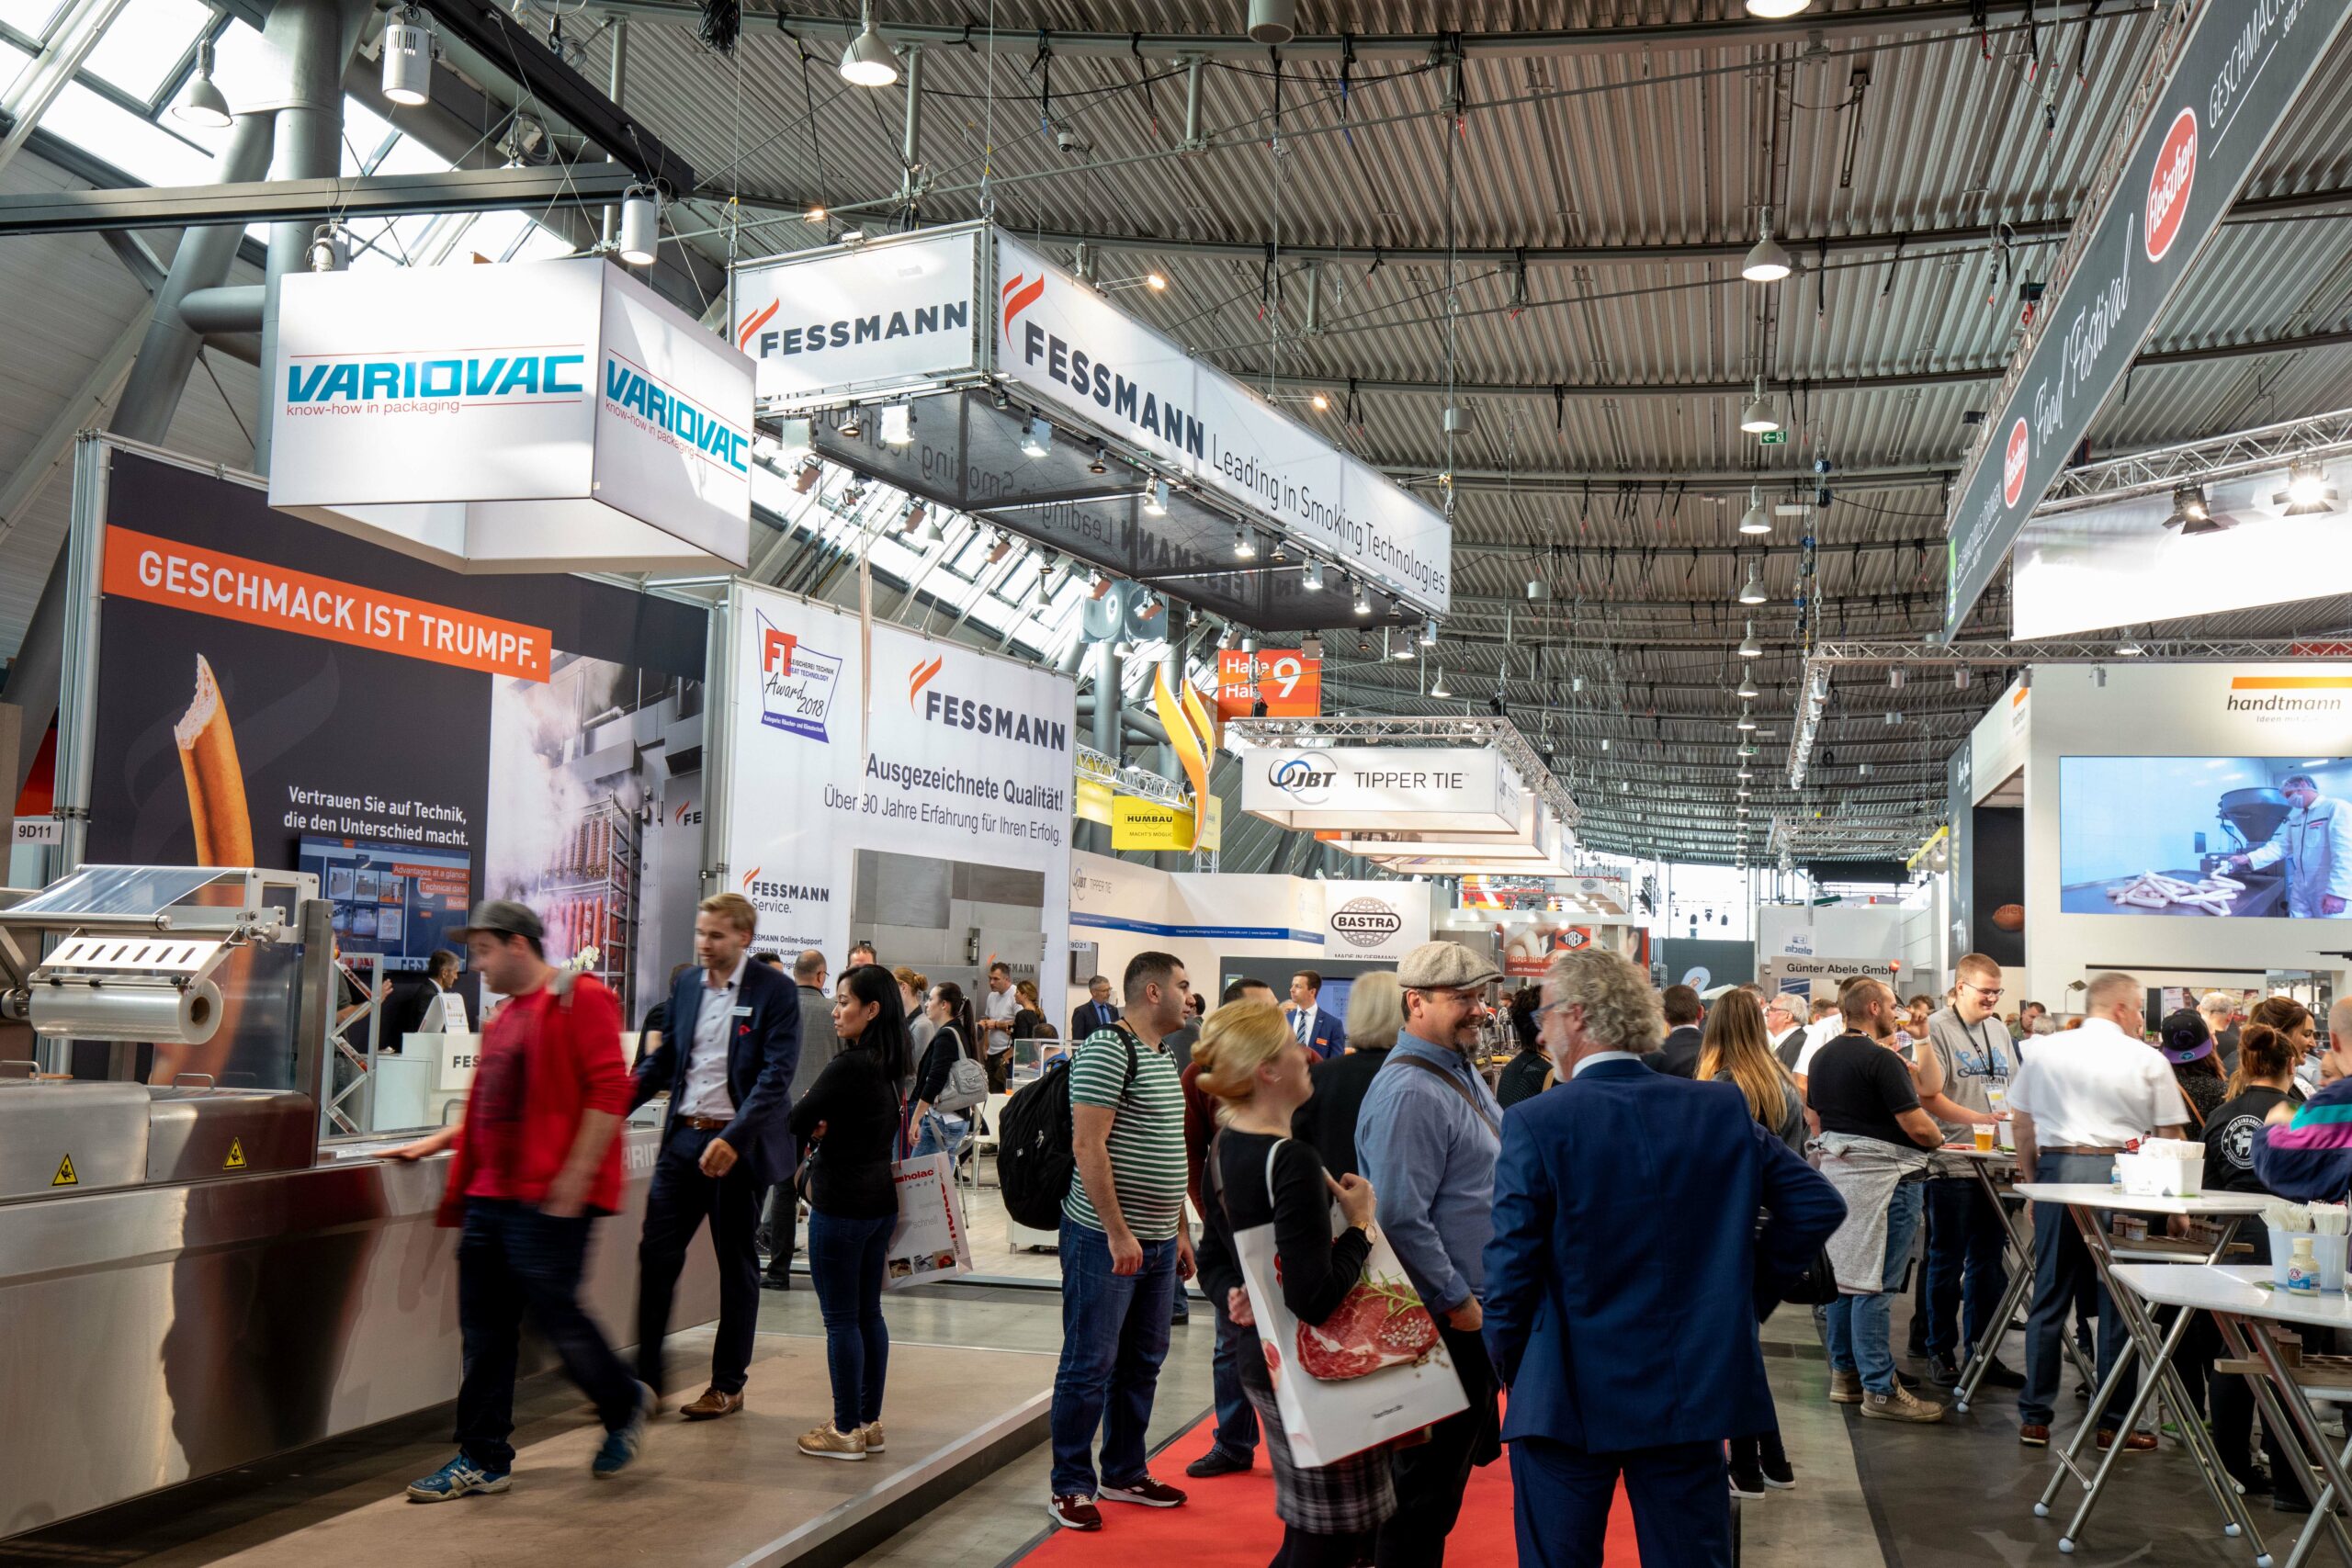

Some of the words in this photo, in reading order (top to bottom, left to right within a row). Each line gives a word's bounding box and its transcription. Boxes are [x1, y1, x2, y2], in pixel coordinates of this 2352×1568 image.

[760, 300, 967, 359] FESSMANN
[2035, 335, 2069, 458] Food
[2071, 213, 2134, 398] Festival
[287, 355, 583, 402] VARIOVAC
[287, 403, 363, 417] know-how
[367, 401, 379, 413] in
[383, 400, 459, 416] packaging
[605, 358, 749, 473] VARIOVAC
[605, 400, 647, 433] know-how
[649, 423, 656, 435] in
[657, 428, 695, 459] packaging
[1025, 320, 1204, 460] FESSMANN
[1213, 434, 1278, 510] Leading
[1283, 475, 1296, 512] in
[1301, 486, 1363, 555] Smoking
[1366, 522, 1445, 594] Technologies
[139, 551, 356, 630] GESCHMACK
[365, 602, 411, 640] IST
[419, 615, 537, 668] TRUMPF.
[764, 628, 797, 677] FT
[765, 671, 807, 700] Award
[1227, 657, 1270, 674] Hale
[1273, 658, 1301, 698] 9
[1226, 682, 1255, 699] Hal
[797, 696, 824, 717] 2018
[2227, 694, 2341, 711] handtmann
[926, 690, 1066, 751] FESSMANN
[865, 753, 999, 800] Ausgezeichnete
[1003, 779, 1063, 811] Qualität!
[1293, 772, 1337, 788] JBT
[1353, 772, 1426, 789] TIPPER
[1433, 773, 1464, 789] TIE
[288, 785, 361, 811] Vertrauen
[365, 795, 386, 813] Sie
[390, 801, 411, 817] auf
[413, 802, 467, 825] Technik,
[684, 811, 702, 826] FE
[824, 784, 857, 812] Über
[862, 794, 878, 815] 90
[881, 796, 917, 820] Jahre
[922, 804, 978, 834] Erfahrung
[981, 813, 997, 833] für
[1000, 816, 1027, 838] Ihren
[1030, 821, 1062, 847] Erfolg.
[1127, 815, 1173, 823] HUMBAU
[18, 825, 51, 838] 9D11
[284, 812, 307, 829] die
[311, 814, 336, 833] den
[340, 818, 423, 841] Unterschied
[426, 829, 469, 846] macht.
[393, 865, 431, 877] Advantages
[446, 870, 467, 879] glance
[422, 882, 451, 892] Technical
[752, 881, 830, 902] FESSMANN
[752, 898, 792, 914] Service.
[1338, 917, 1394, 928] BASTRA
[752, 933, 778, 942] SSMANN
[780, 935, 822, 945] Online-Support
[780, 949, 802, 957] Academ
[1785, 944, 1813, 955] abele
[1787, 963, 1825, 974] Günter
[1827, 964, 1859, 975] Abele
[453, 1055, 481, 1068] FES
[904, 1168, 933, 1181] holac
[912, 1215, 938, 1229] schnell
